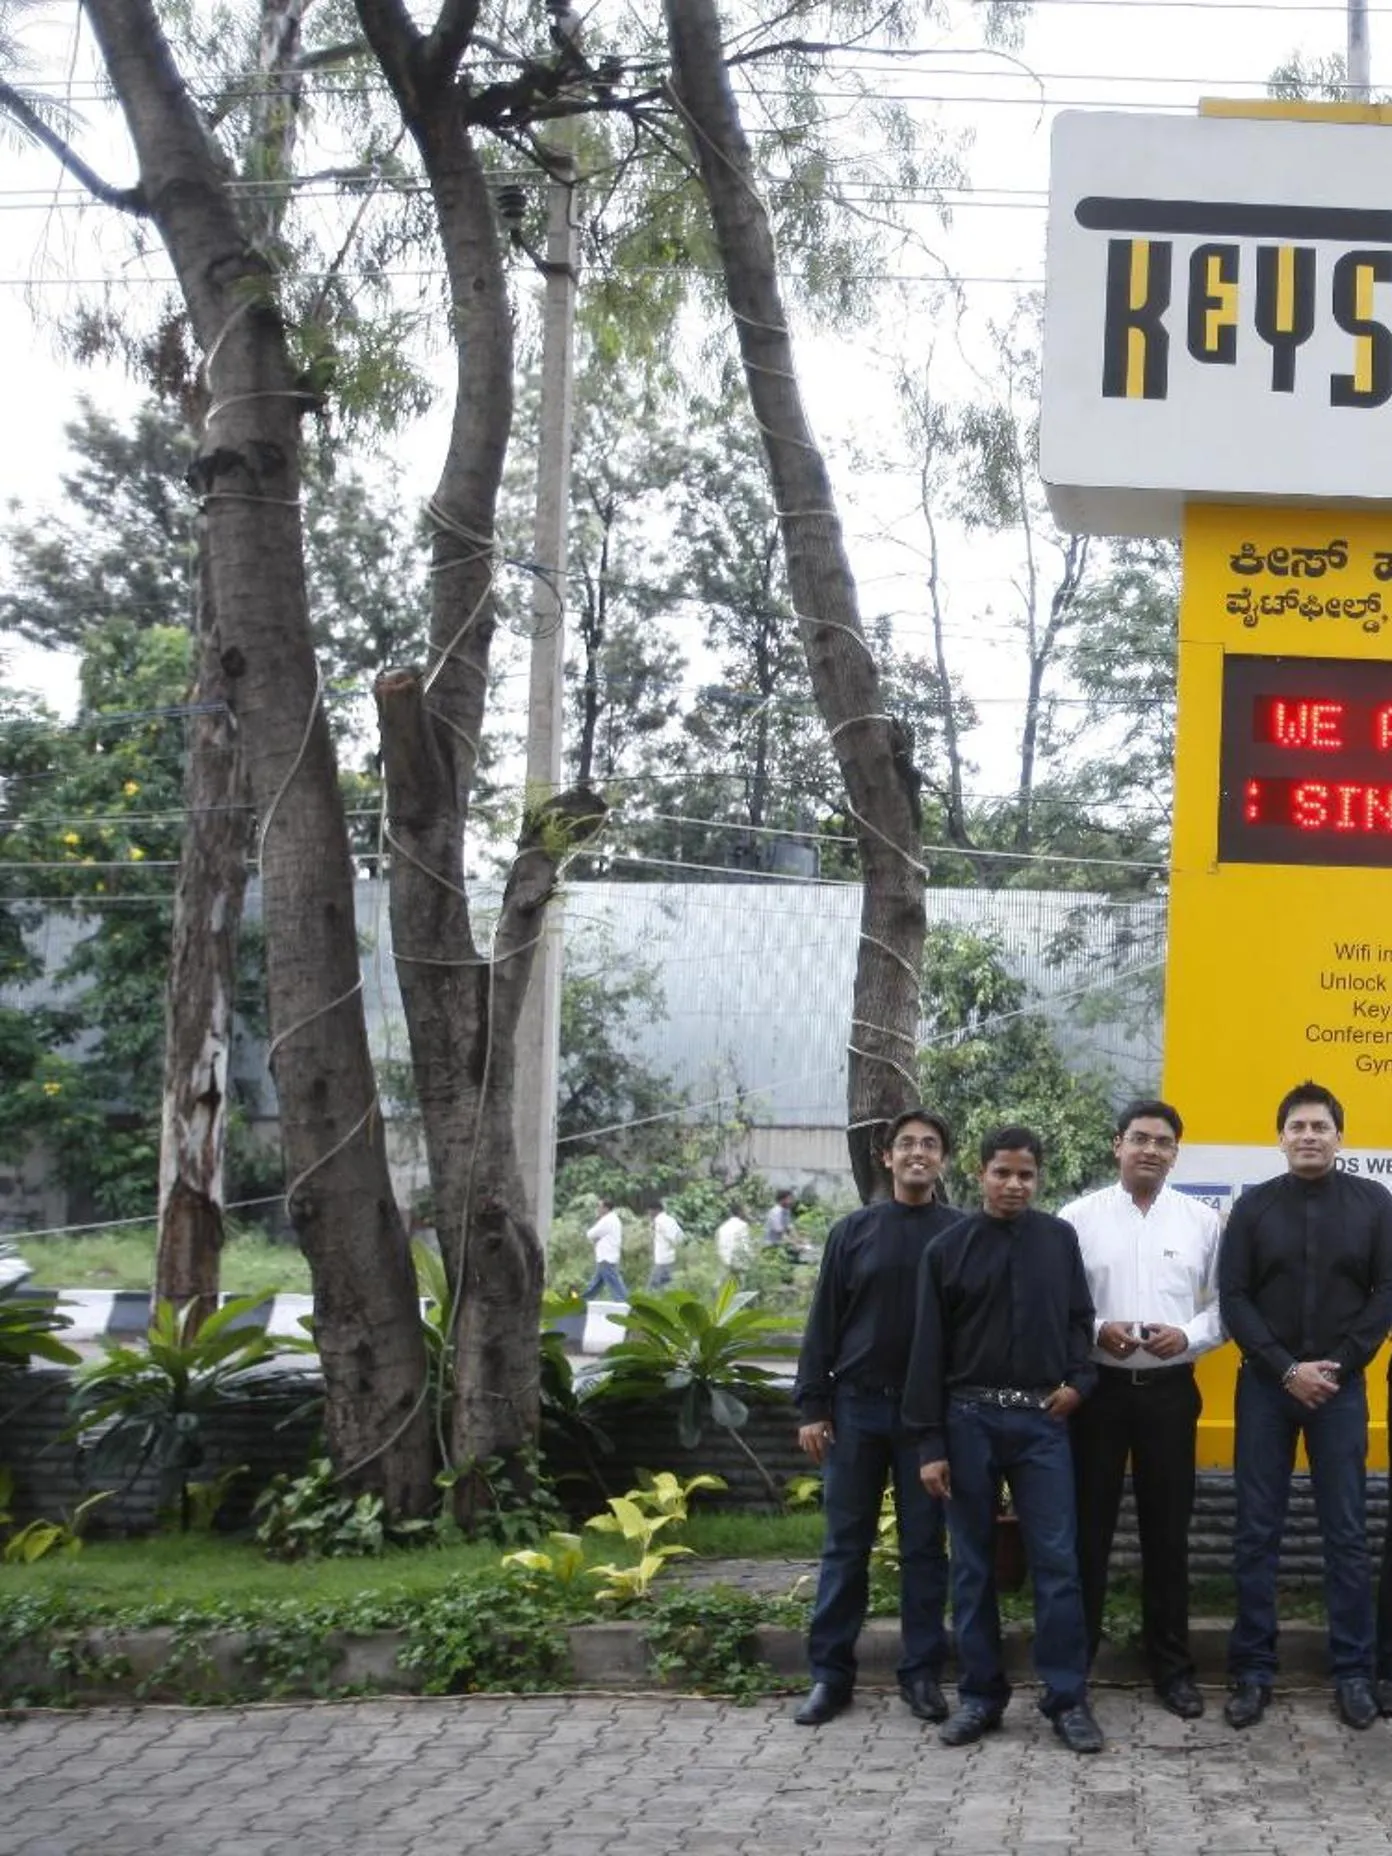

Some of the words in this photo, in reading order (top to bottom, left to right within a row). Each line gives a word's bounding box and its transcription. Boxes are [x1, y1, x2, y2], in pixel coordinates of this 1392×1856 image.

[1229, 540, 1350, 579] ಕೀಸ್
[1274, 700, 1344, 748] WE
[1334, 942, 1371, 961] Wifi
[1319, 971, 1387, 992] Unlock
